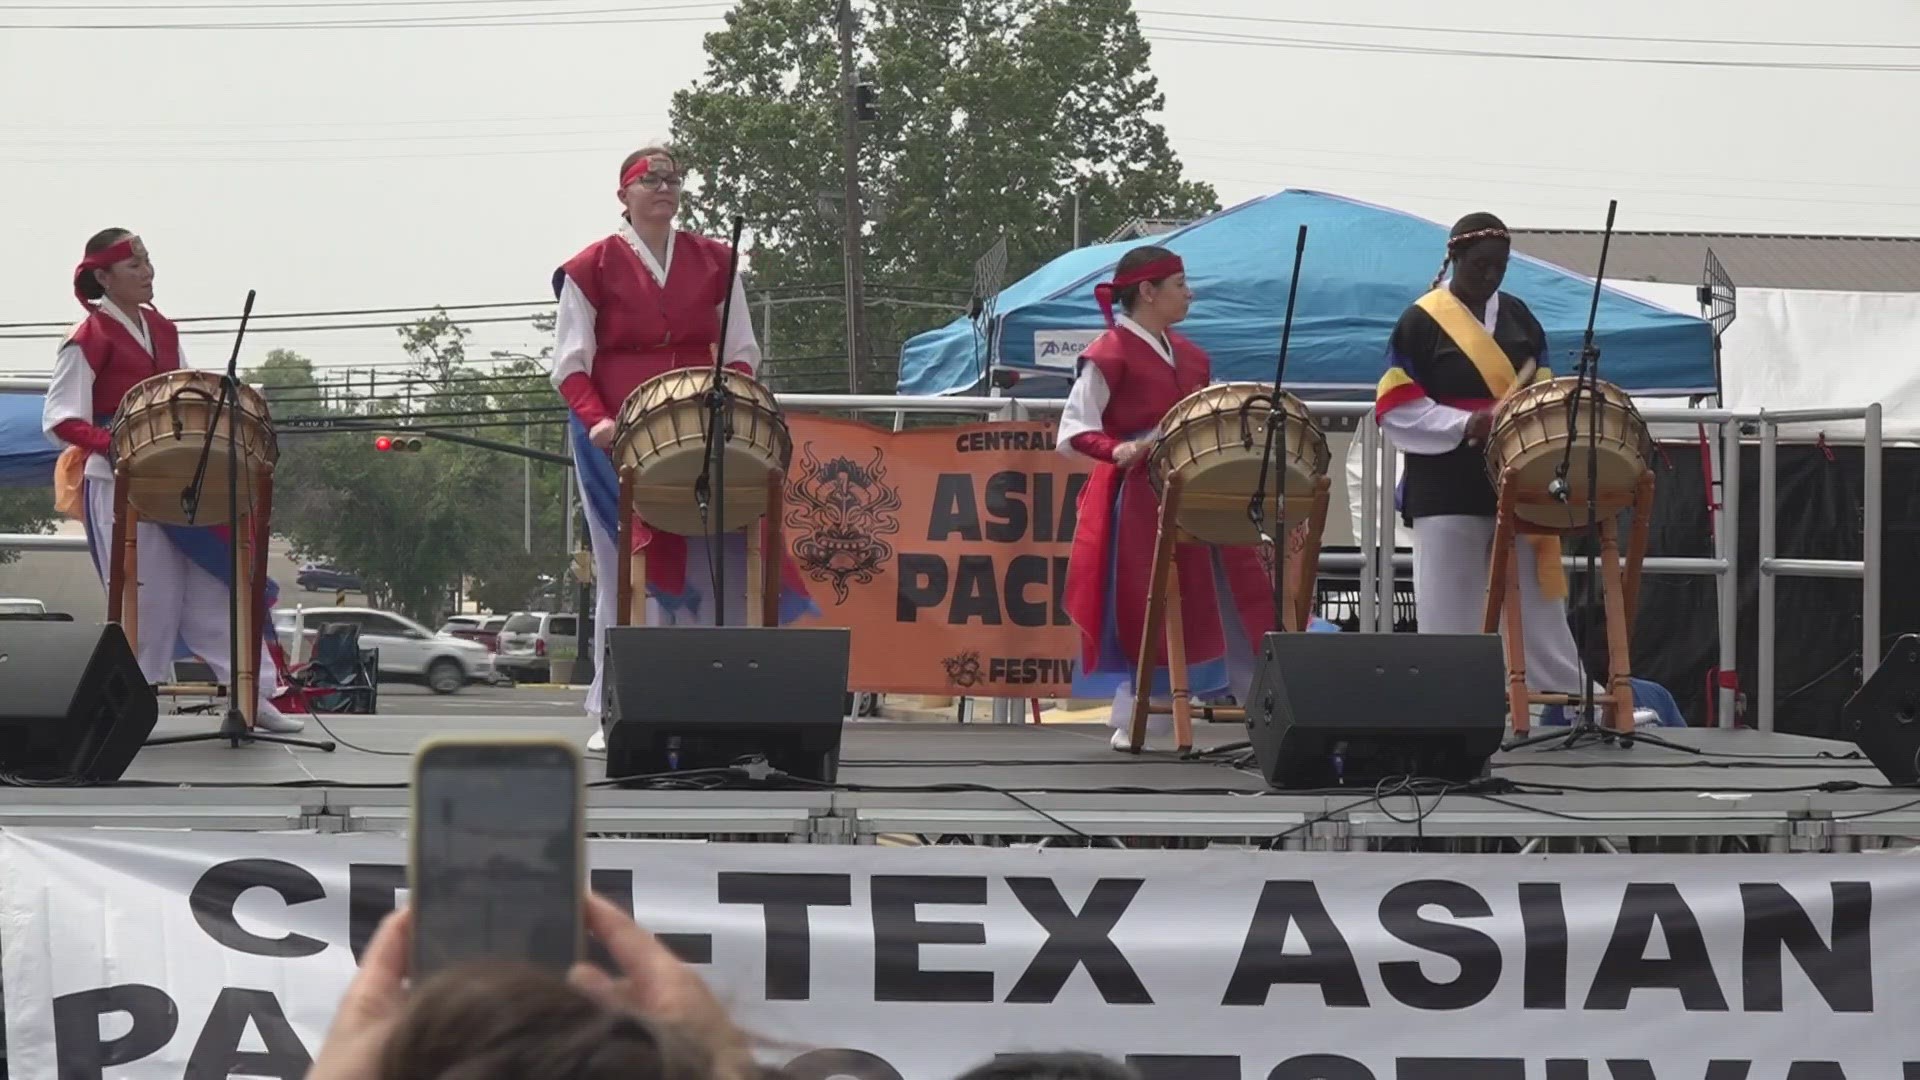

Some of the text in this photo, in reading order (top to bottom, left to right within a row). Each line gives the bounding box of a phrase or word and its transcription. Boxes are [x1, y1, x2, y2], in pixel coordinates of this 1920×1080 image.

[956, 431, 1057, 453] CENTRAL
[896, 553, 1073, 627] PACI
[989, 657, 1073, 684] FESTIV
[188, 857, 1875, 1014] C-TEX ASIAN
